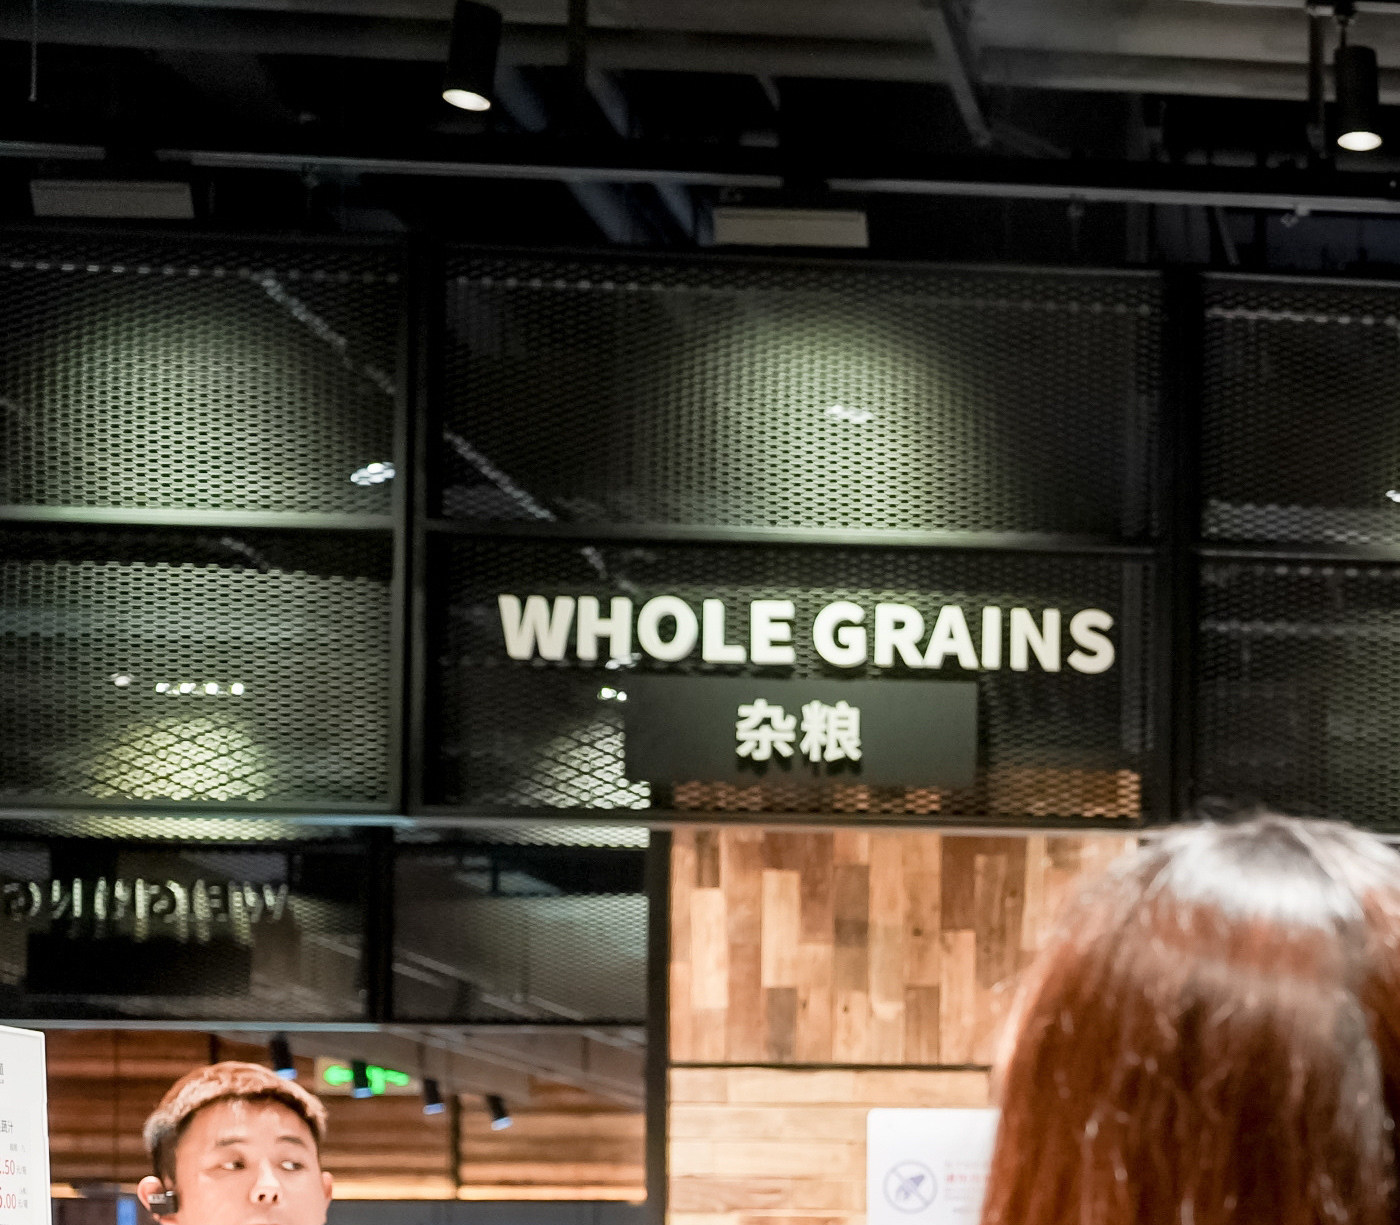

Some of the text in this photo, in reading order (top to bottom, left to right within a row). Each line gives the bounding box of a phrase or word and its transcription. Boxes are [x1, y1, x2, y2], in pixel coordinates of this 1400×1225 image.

[498, 595, 1115, 674] WHOLE GRAINS
[735, 698, 862, 763] 杂粮
